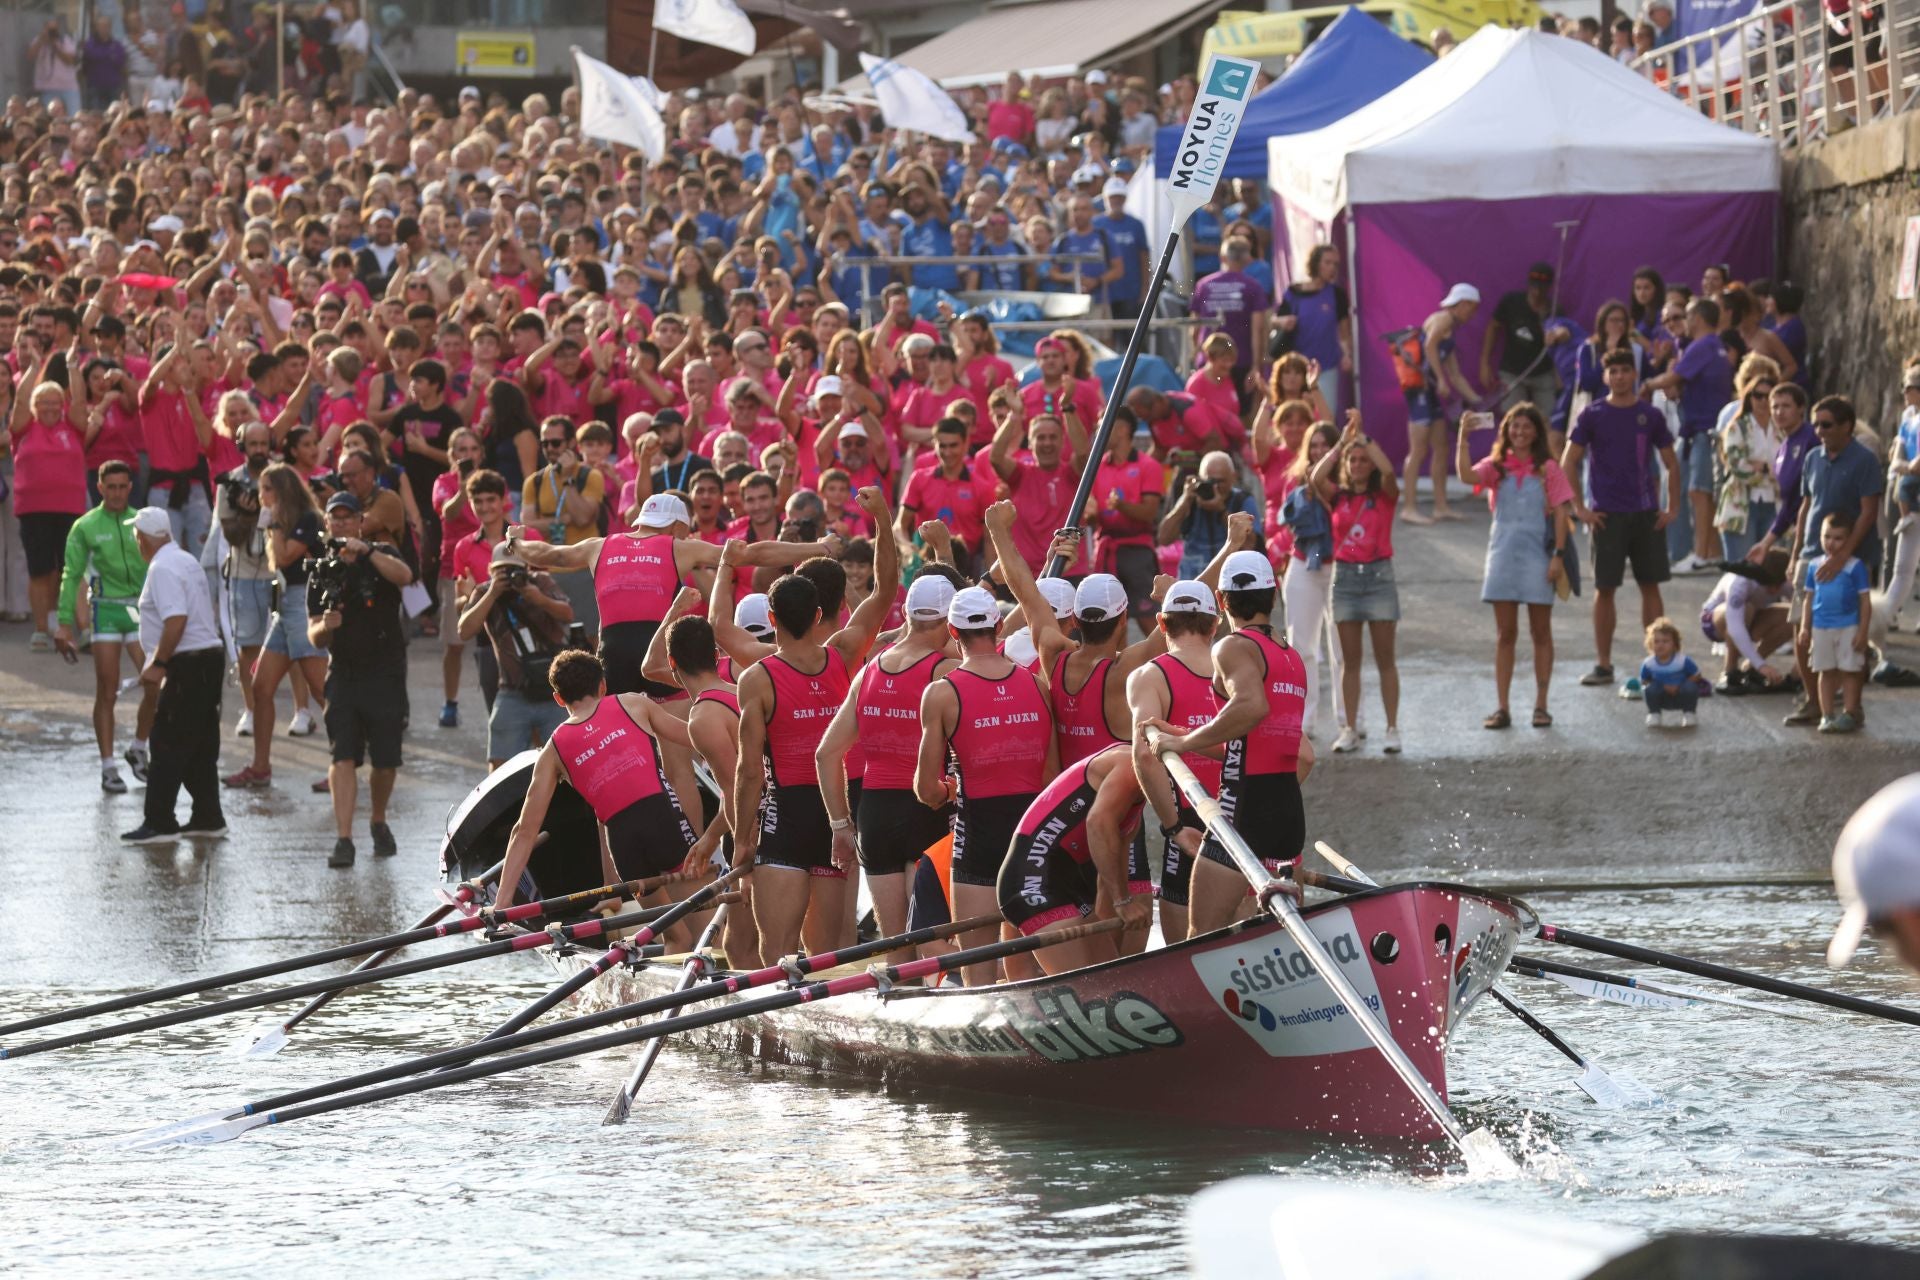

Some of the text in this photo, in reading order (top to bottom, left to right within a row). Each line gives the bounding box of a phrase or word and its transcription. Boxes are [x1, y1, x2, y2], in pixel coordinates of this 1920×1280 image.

[1173, 100, 1220, 189] MOYUA
[1193, 111, 1236, 186] Homes
[606, 555, 662, 566] SAN JUAN
[1272, 682, 1293, 694] SAN
[793, 704, 844, 719] SAN JUA
[863, 705, 917, 719] SAN JUAN
[974, 712, 1040, 729] SAN JUAN
[575, 747, 597, 766] SAN
[598, 728, 627, 750] JUAN
[1069, 726, 1096, 736] JUAN
[1223, 739, 1243, 782] SAN
[1026, 816, 1068, 868] JUAN
[1020, 875, 1048, 907] SAN
[1230, 931, 1360, 996] sistiaa
[1592, 981, 1673, 1008] Homes
[1000, 984, 1184, 1064] bike
